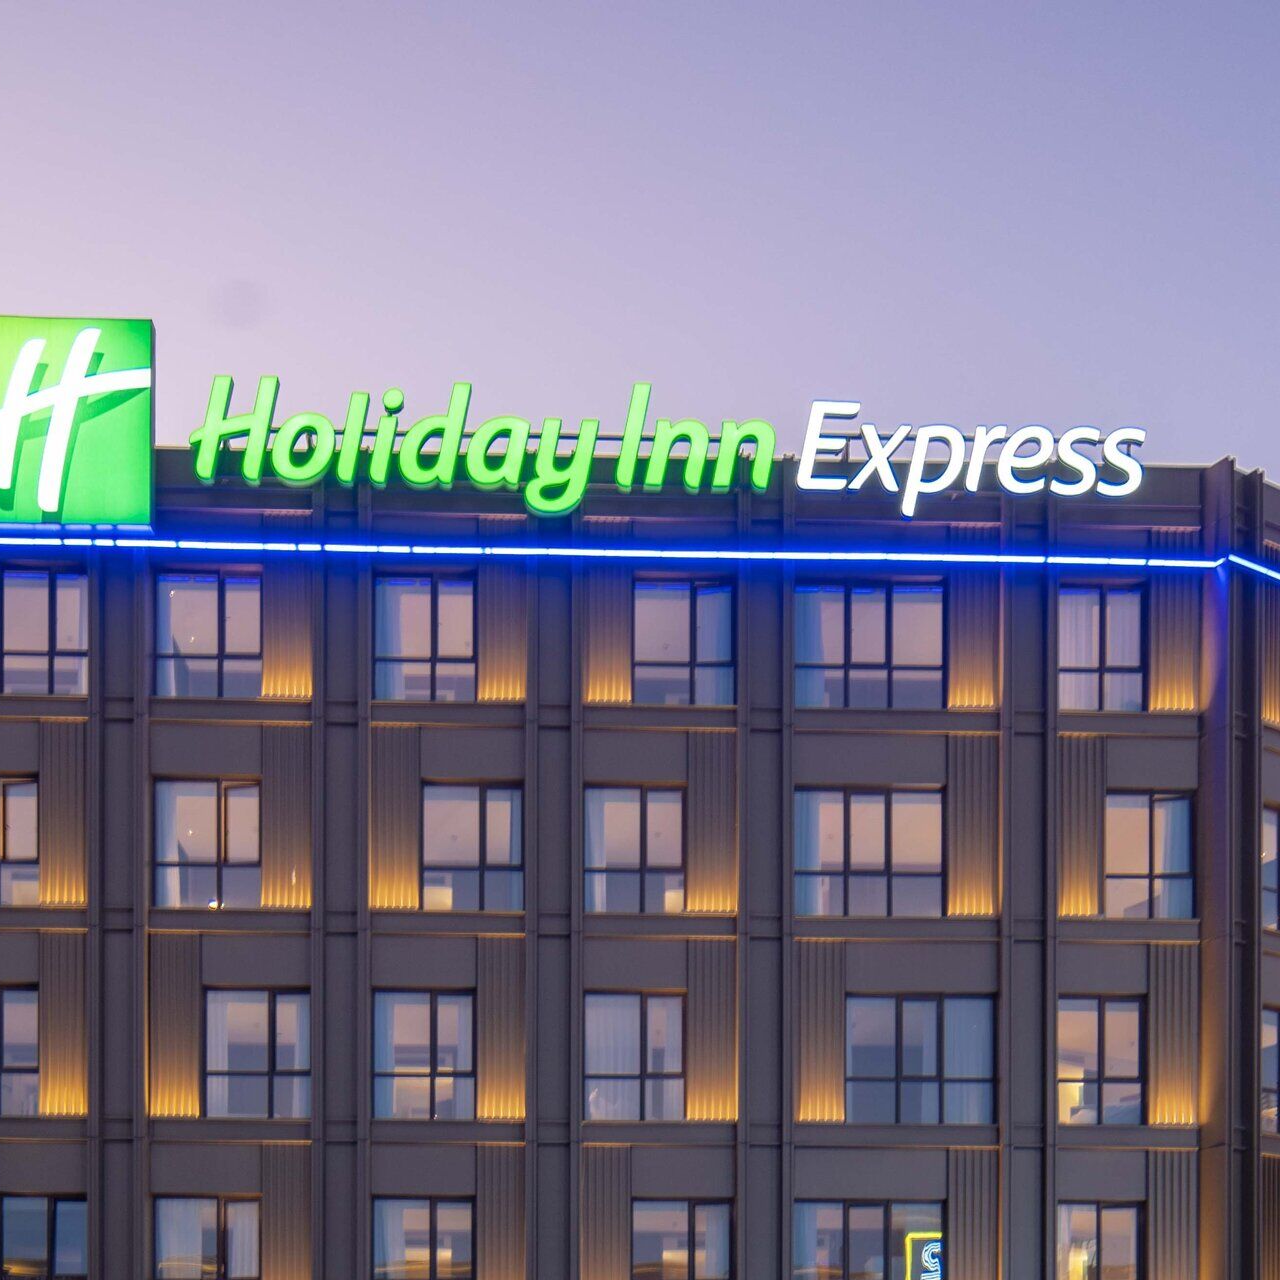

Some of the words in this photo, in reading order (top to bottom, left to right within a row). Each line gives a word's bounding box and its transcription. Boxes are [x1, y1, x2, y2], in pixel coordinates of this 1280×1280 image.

[190, 374, 599, 517] Holiday
[615, 382, 776, 494] Inn
[797, 400, 1147, 518] Express
